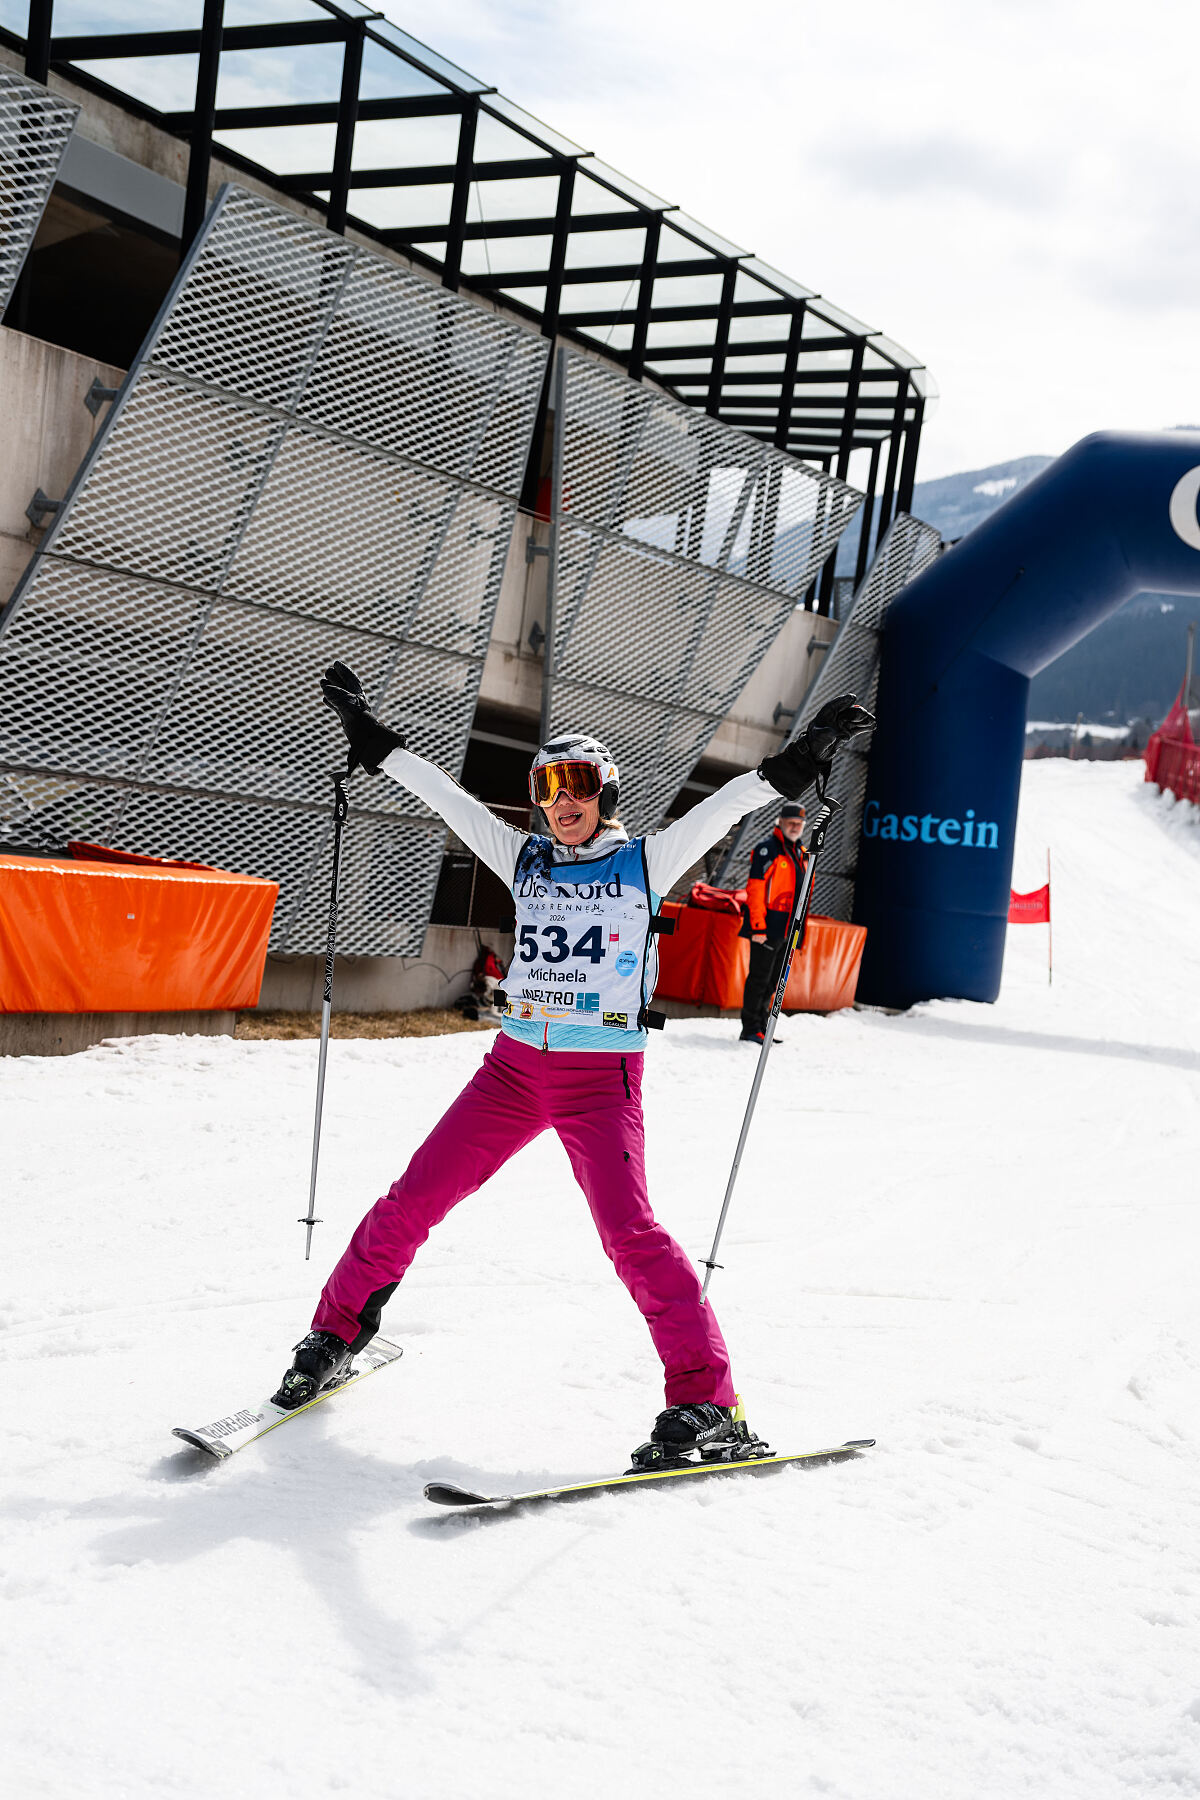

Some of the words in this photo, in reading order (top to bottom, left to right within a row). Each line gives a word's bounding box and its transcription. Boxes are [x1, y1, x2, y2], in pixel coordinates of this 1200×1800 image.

[863, 800, 998, 849] Gastein
[518, 874, 548, 898] Die
[550, 903, 600, 911] RENNEN
[518, 925, 606, 964] 534
[528, 968, 587, 983] Michaela
[696, 1427, 717, 1441] ATOMIC
